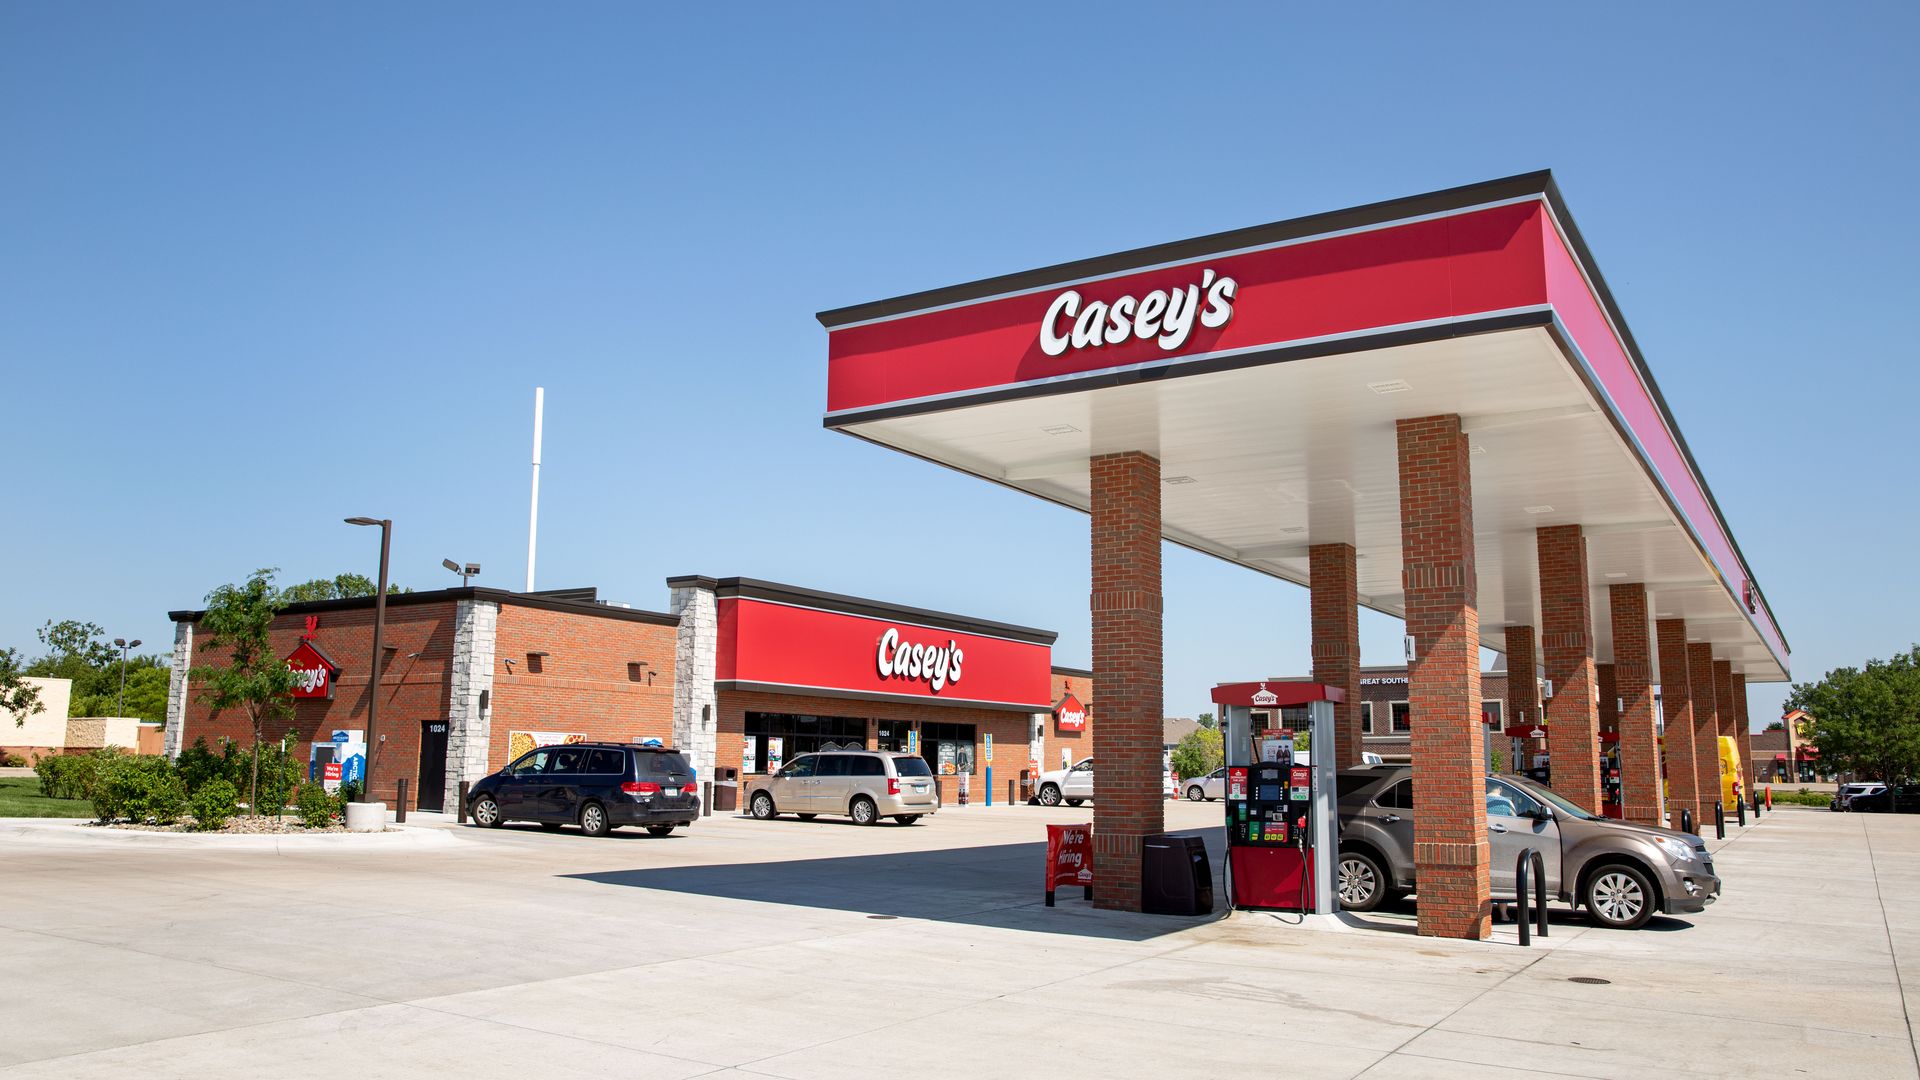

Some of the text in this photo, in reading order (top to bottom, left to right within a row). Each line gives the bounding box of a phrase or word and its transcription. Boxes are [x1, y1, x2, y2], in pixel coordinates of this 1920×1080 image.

[1040, 268, 1238, 357] Casey's
[878, 628, 964, 691] Casey's
[1255, 694, 1275, 703] Casey's
[1061, 707, 1085, 727] Casey's
[430, 724, 446, 733] 1024
[1063, 830, 1084, 845] We're
[1058, 849, 1082, 867] Hiring
